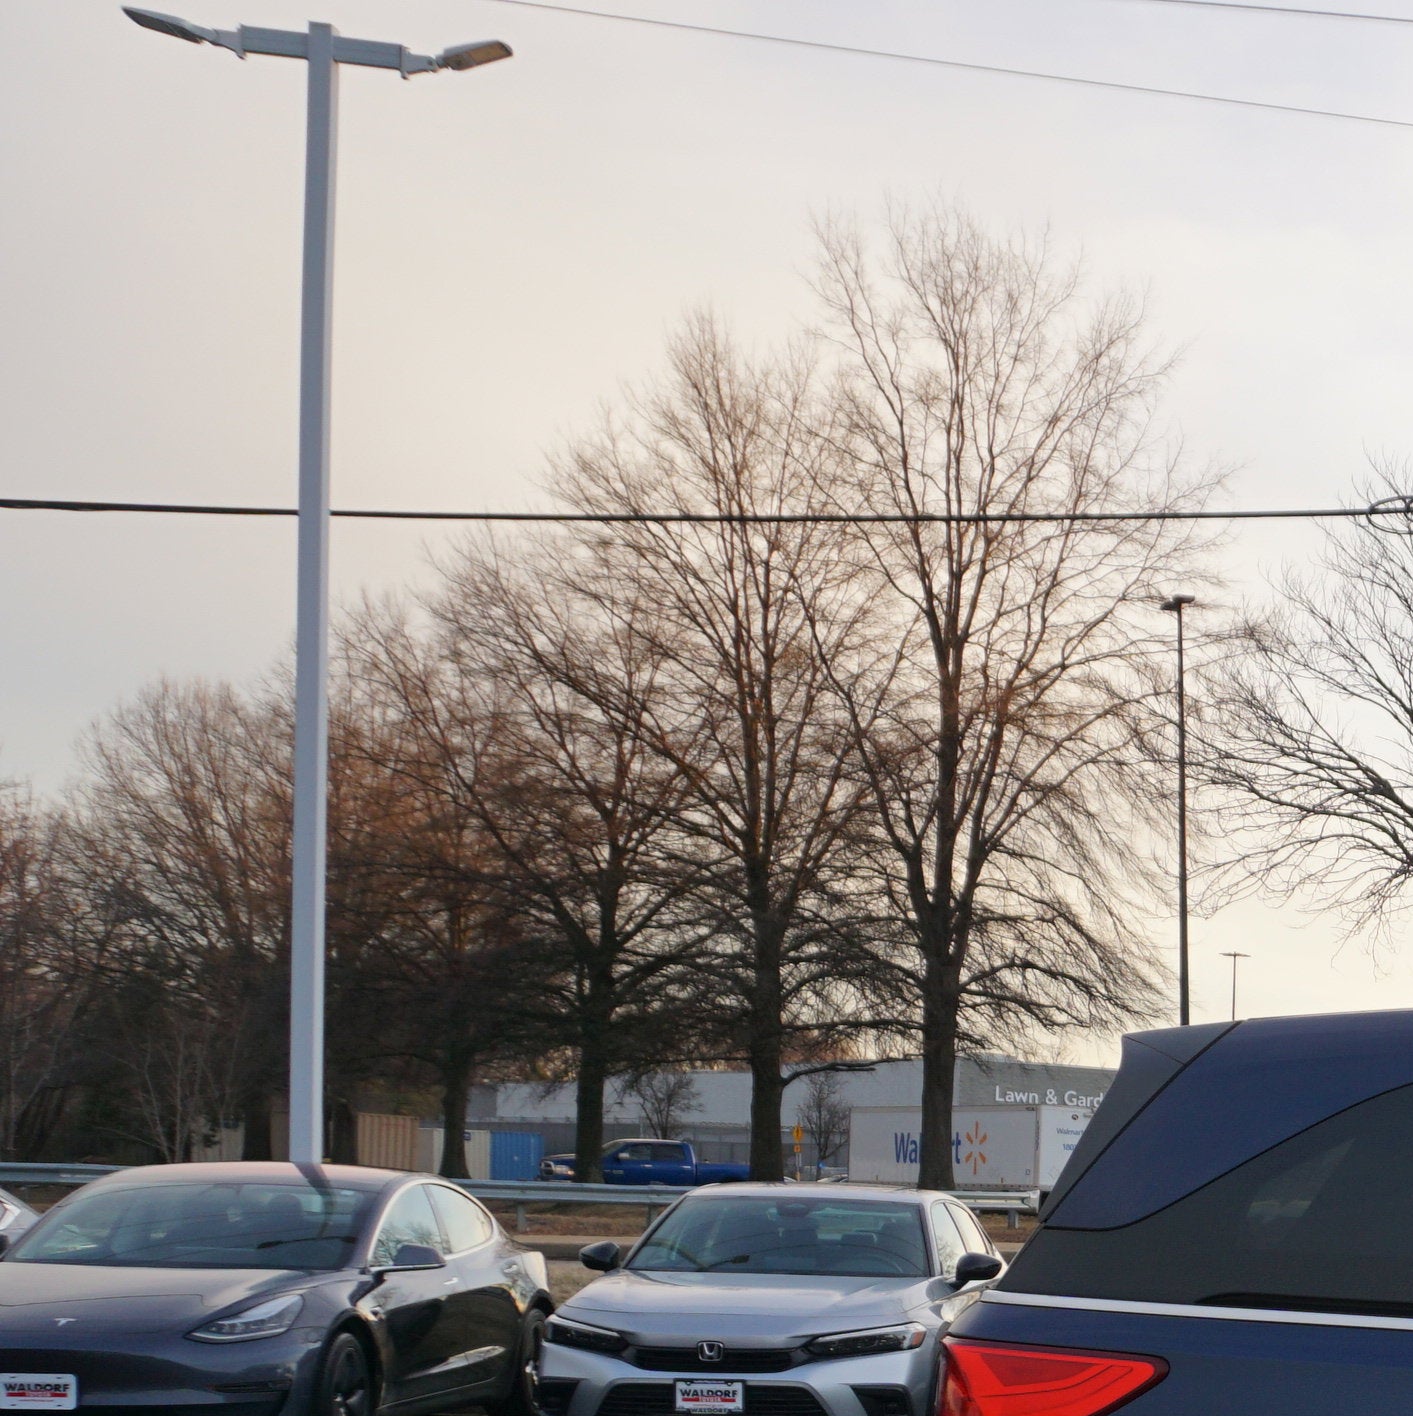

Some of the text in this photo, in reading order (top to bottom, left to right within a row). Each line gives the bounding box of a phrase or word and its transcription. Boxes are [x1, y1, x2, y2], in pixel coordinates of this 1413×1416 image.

[995, 1085, 1038, 1104] Lawn
[1045, 1089, 1058, 1105] &
[4, 1383, 70, 1392] WALDORF
[680, 1389, 737, 1398] WALDORF
